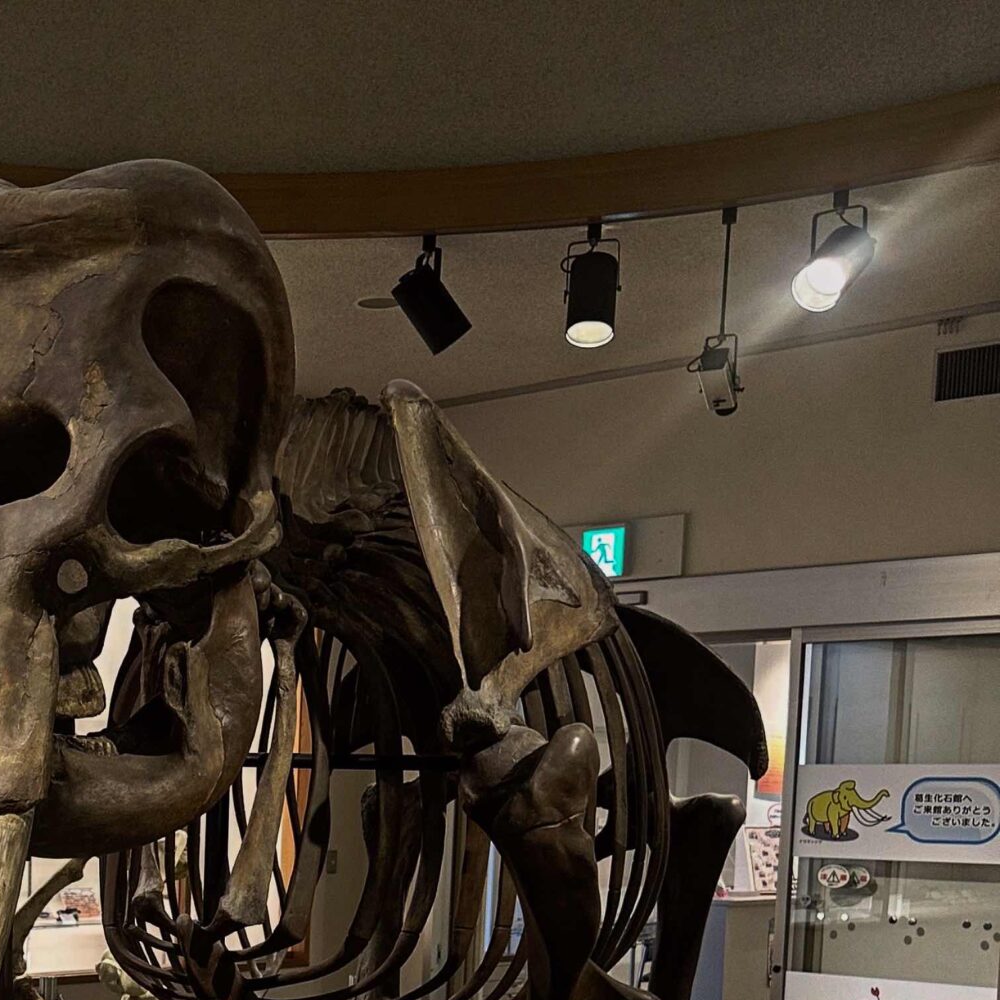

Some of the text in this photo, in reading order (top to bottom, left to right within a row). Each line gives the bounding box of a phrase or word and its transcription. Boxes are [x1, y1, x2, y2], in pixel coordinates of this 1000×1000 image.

[915, 793, 973, 803] 葛生化石館へ
[913, 805, 991, 815] ご来館ありがとう
[932, 817, 996, 828] ございました。
